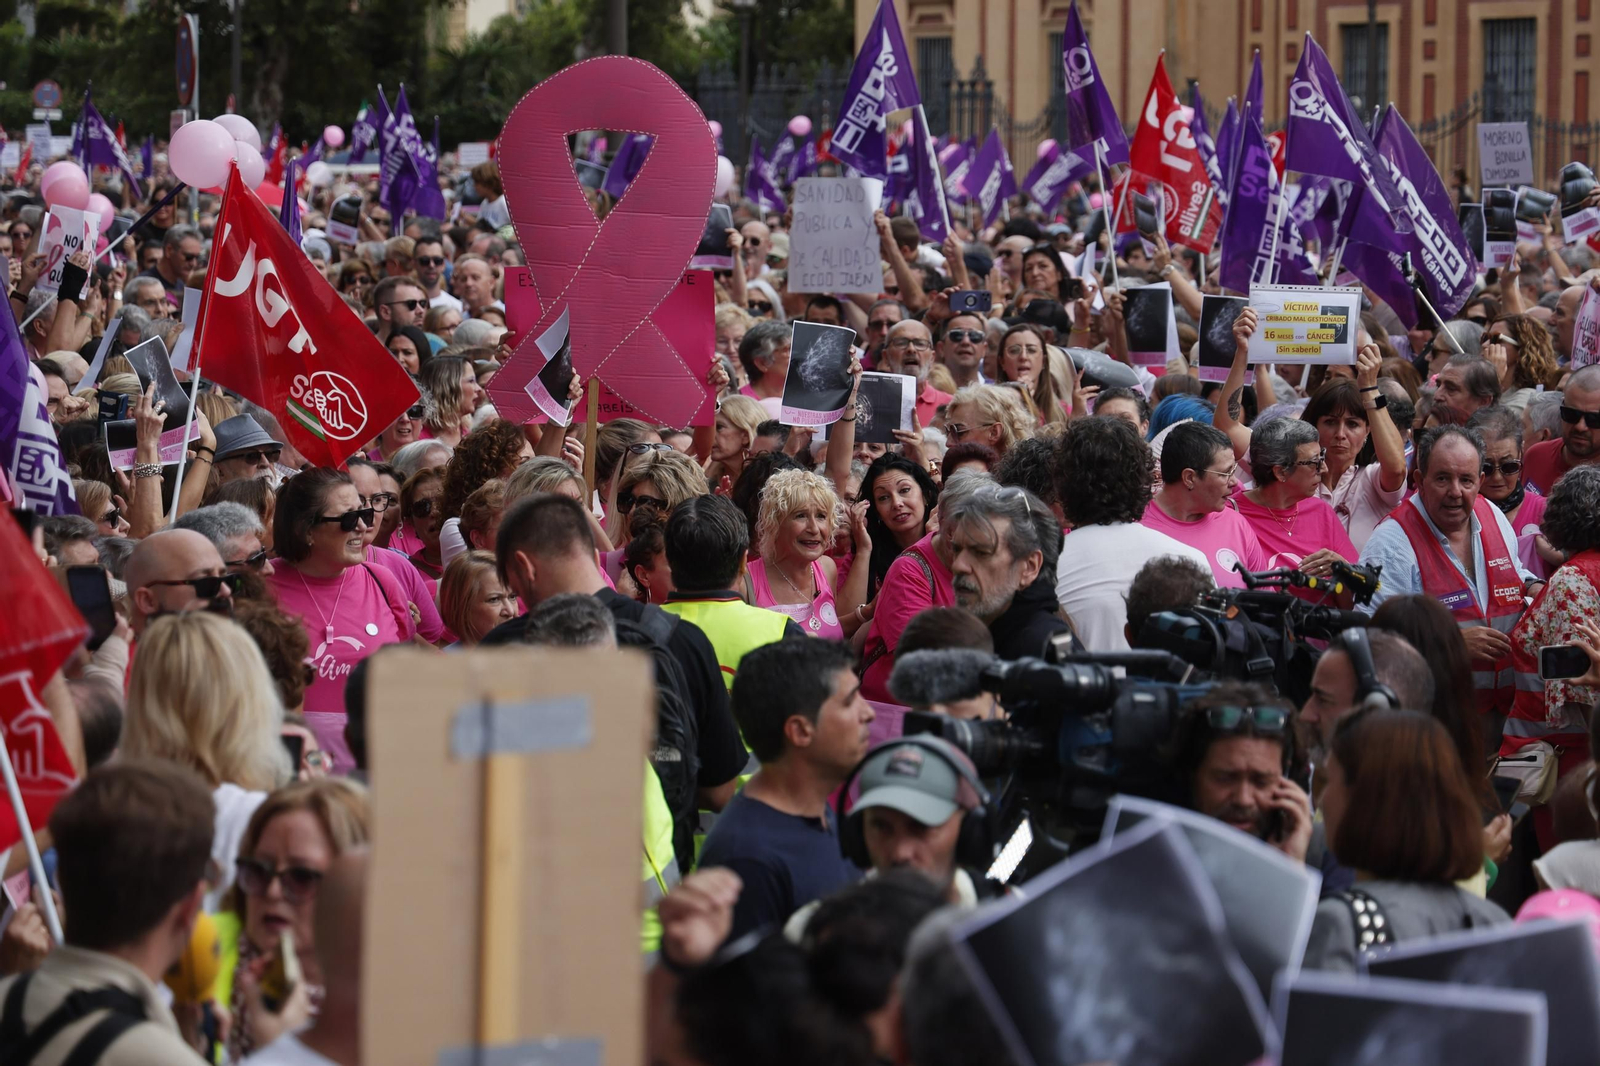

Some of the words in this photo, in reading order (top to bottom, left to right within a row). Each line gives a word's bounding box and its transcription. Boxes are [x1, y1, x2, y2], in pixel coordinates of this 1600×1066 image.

[1484, 131, 1523, 146] MORENO
[1494, 150, 1527, 165] BONILLA
[797, 183, 866, 203] SANIDAD
[795, 211, 853, 234] PUBLICA
[64, 234, 78, 248] NO
[813, 246, 877, 270] CALIDAD
[1421, 247, 1454, 297] Málaga
[1284, 303, 1319, 312] VÍCTIMA
[1264, 331, 1276, 339] 16
[1306, 332, 1335, 340] CÁNCER
[1292, 346, 1322, 354] saberlo!
[1494, 586, 1514, 597] CCOO
